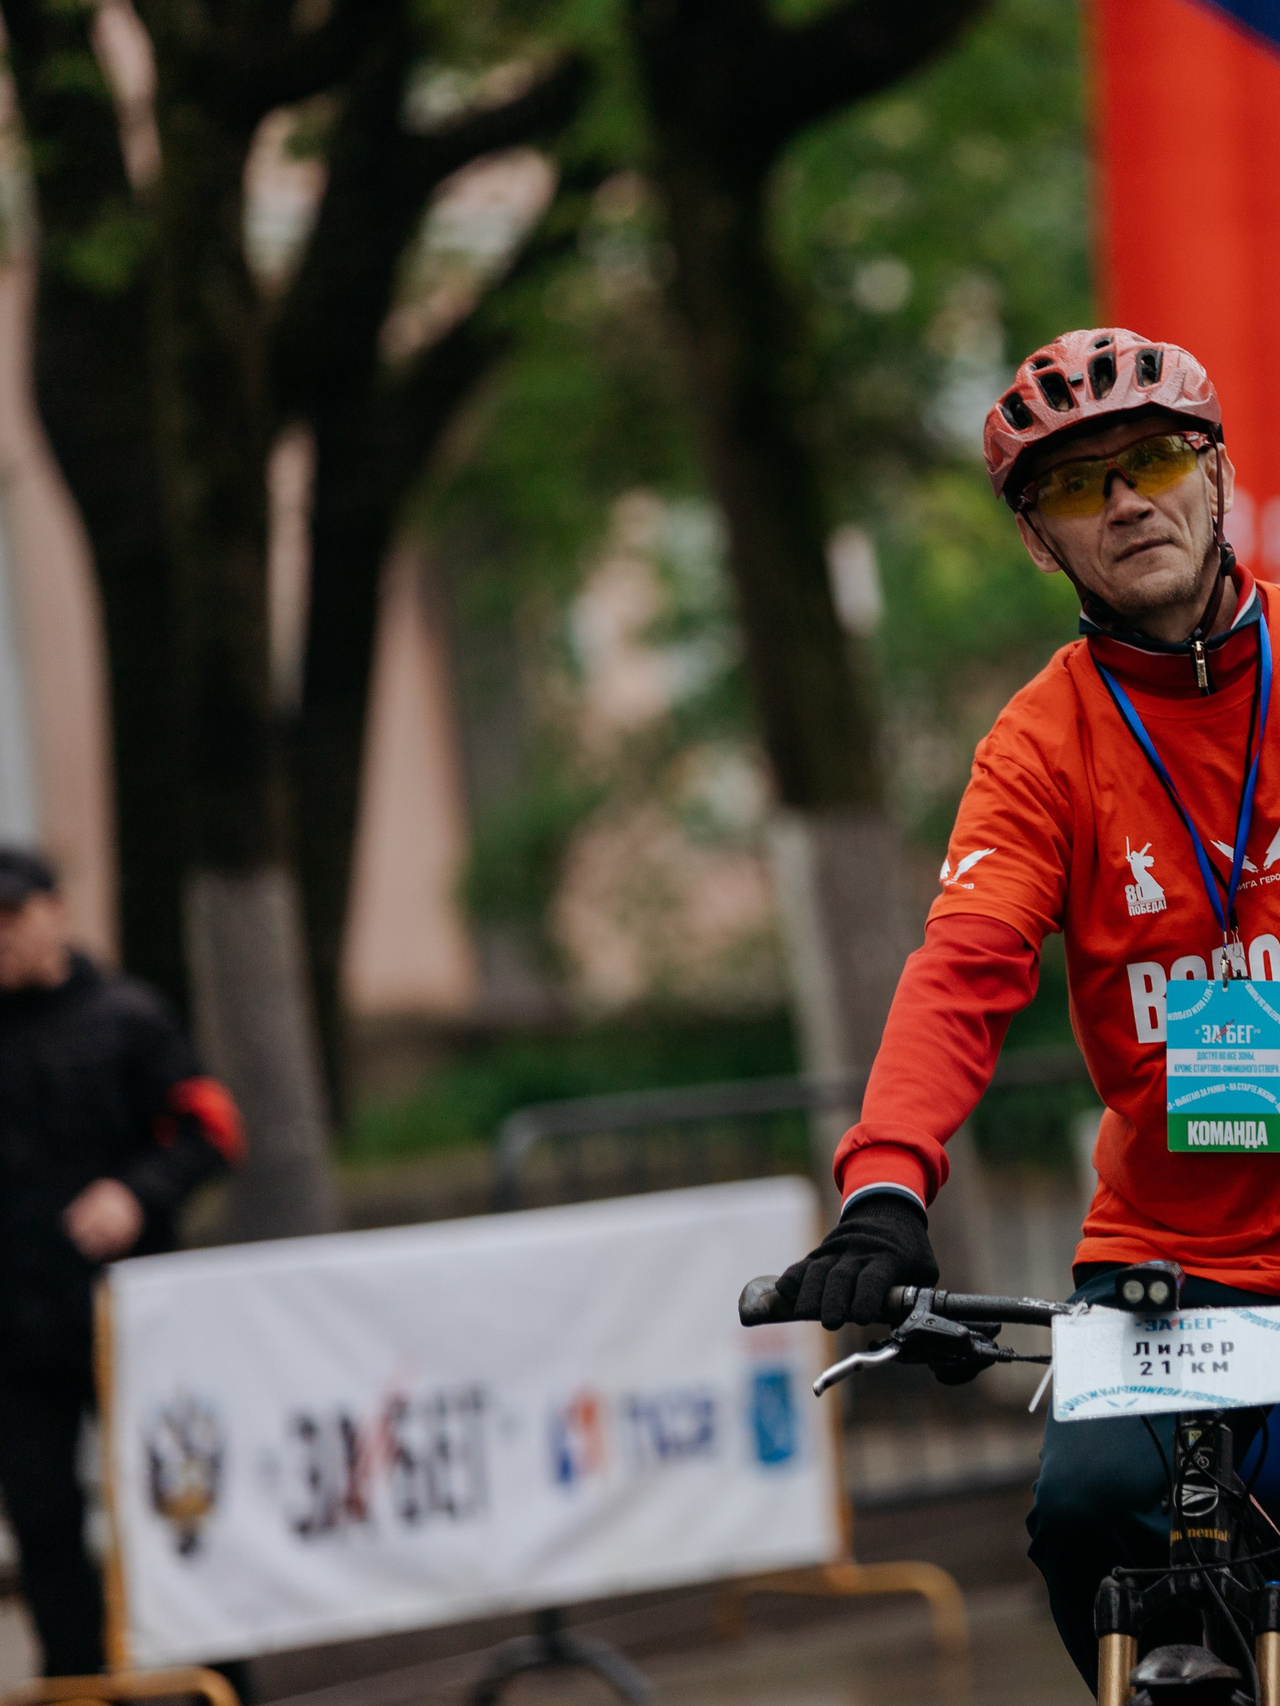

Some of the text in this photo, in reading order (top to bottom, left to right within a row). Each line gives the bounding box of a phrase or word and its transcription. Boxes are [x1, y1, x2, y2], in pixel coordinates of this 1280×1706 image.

[1124, 884, 1143, 904] 80
[1128, 899, 1168, 917] ПОБЕДА!
[1196, 1051, 1218, 1061] ДОСТУП
[1219, 1051, 1227, 1060] ВО
[1227, 1051, 1237, 1060] ВСЕ
[1174, 1064, 1280, 1073] КРОМЕ СТАРТОВО-ФИНИШНОГО СТВОРА
[1207, 1084, 1227, 1095] РАМКИ
[1228, 1082, 1237, 1091] НА
[1237, 1082, 1257, 1093] СТАРТЕ
[1187, 1120, 1269, 1149] КОМАНДА
[1133, 1340, 1235, 1357] Лидер
[1140, 1360, 1230, 1376] 21 км
